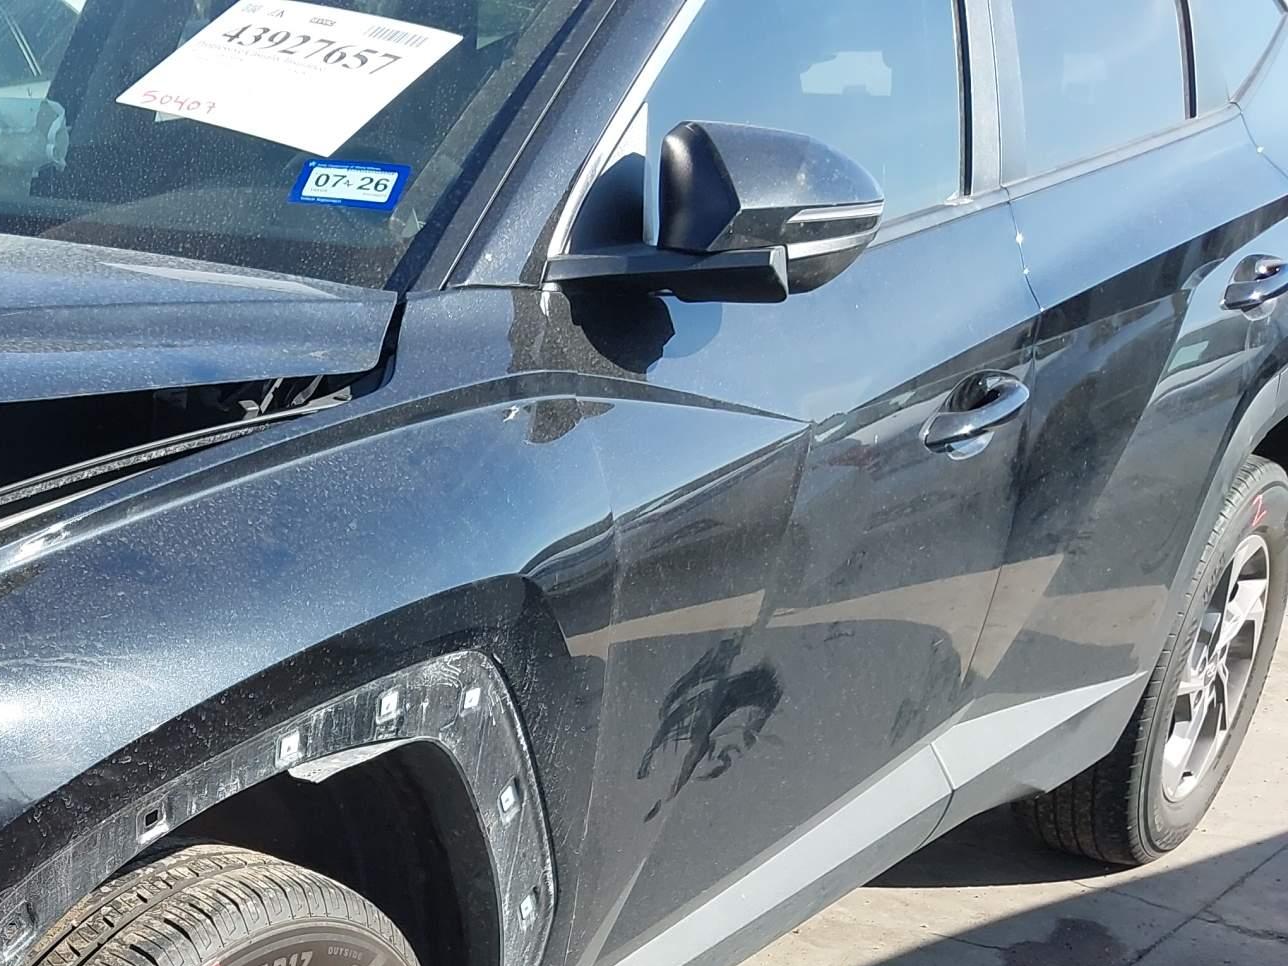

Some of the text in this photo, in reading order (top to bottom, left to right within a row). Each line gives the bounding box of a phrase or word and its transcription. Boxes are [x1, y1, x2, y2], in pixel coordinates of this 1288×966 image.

[222, 24, 403, 75] 43927657
[140, 90, 216, 114] 50407
[356, 176, 390, 193] 26
